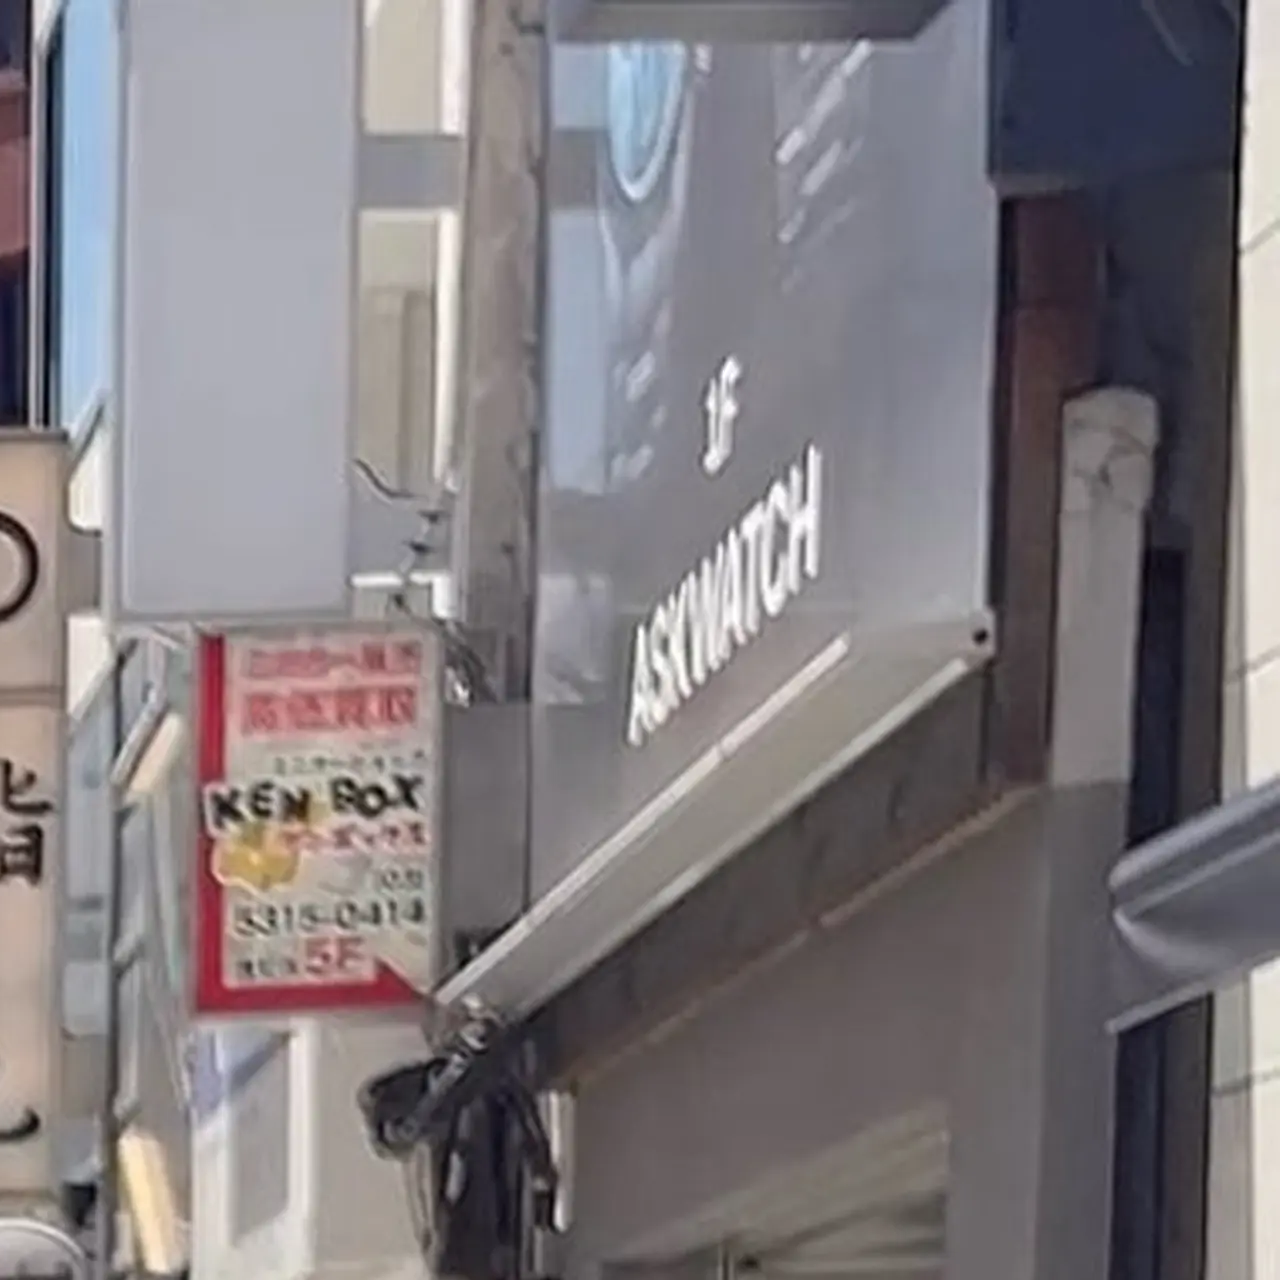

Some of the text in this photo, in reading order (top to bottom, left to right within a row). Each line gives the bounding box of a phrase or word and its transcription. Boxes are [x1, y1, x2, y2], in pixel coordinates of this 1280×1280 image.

[627, 442, 825, 747] ASKWATCH
[208, 774, 424, 832] KEN BOX
